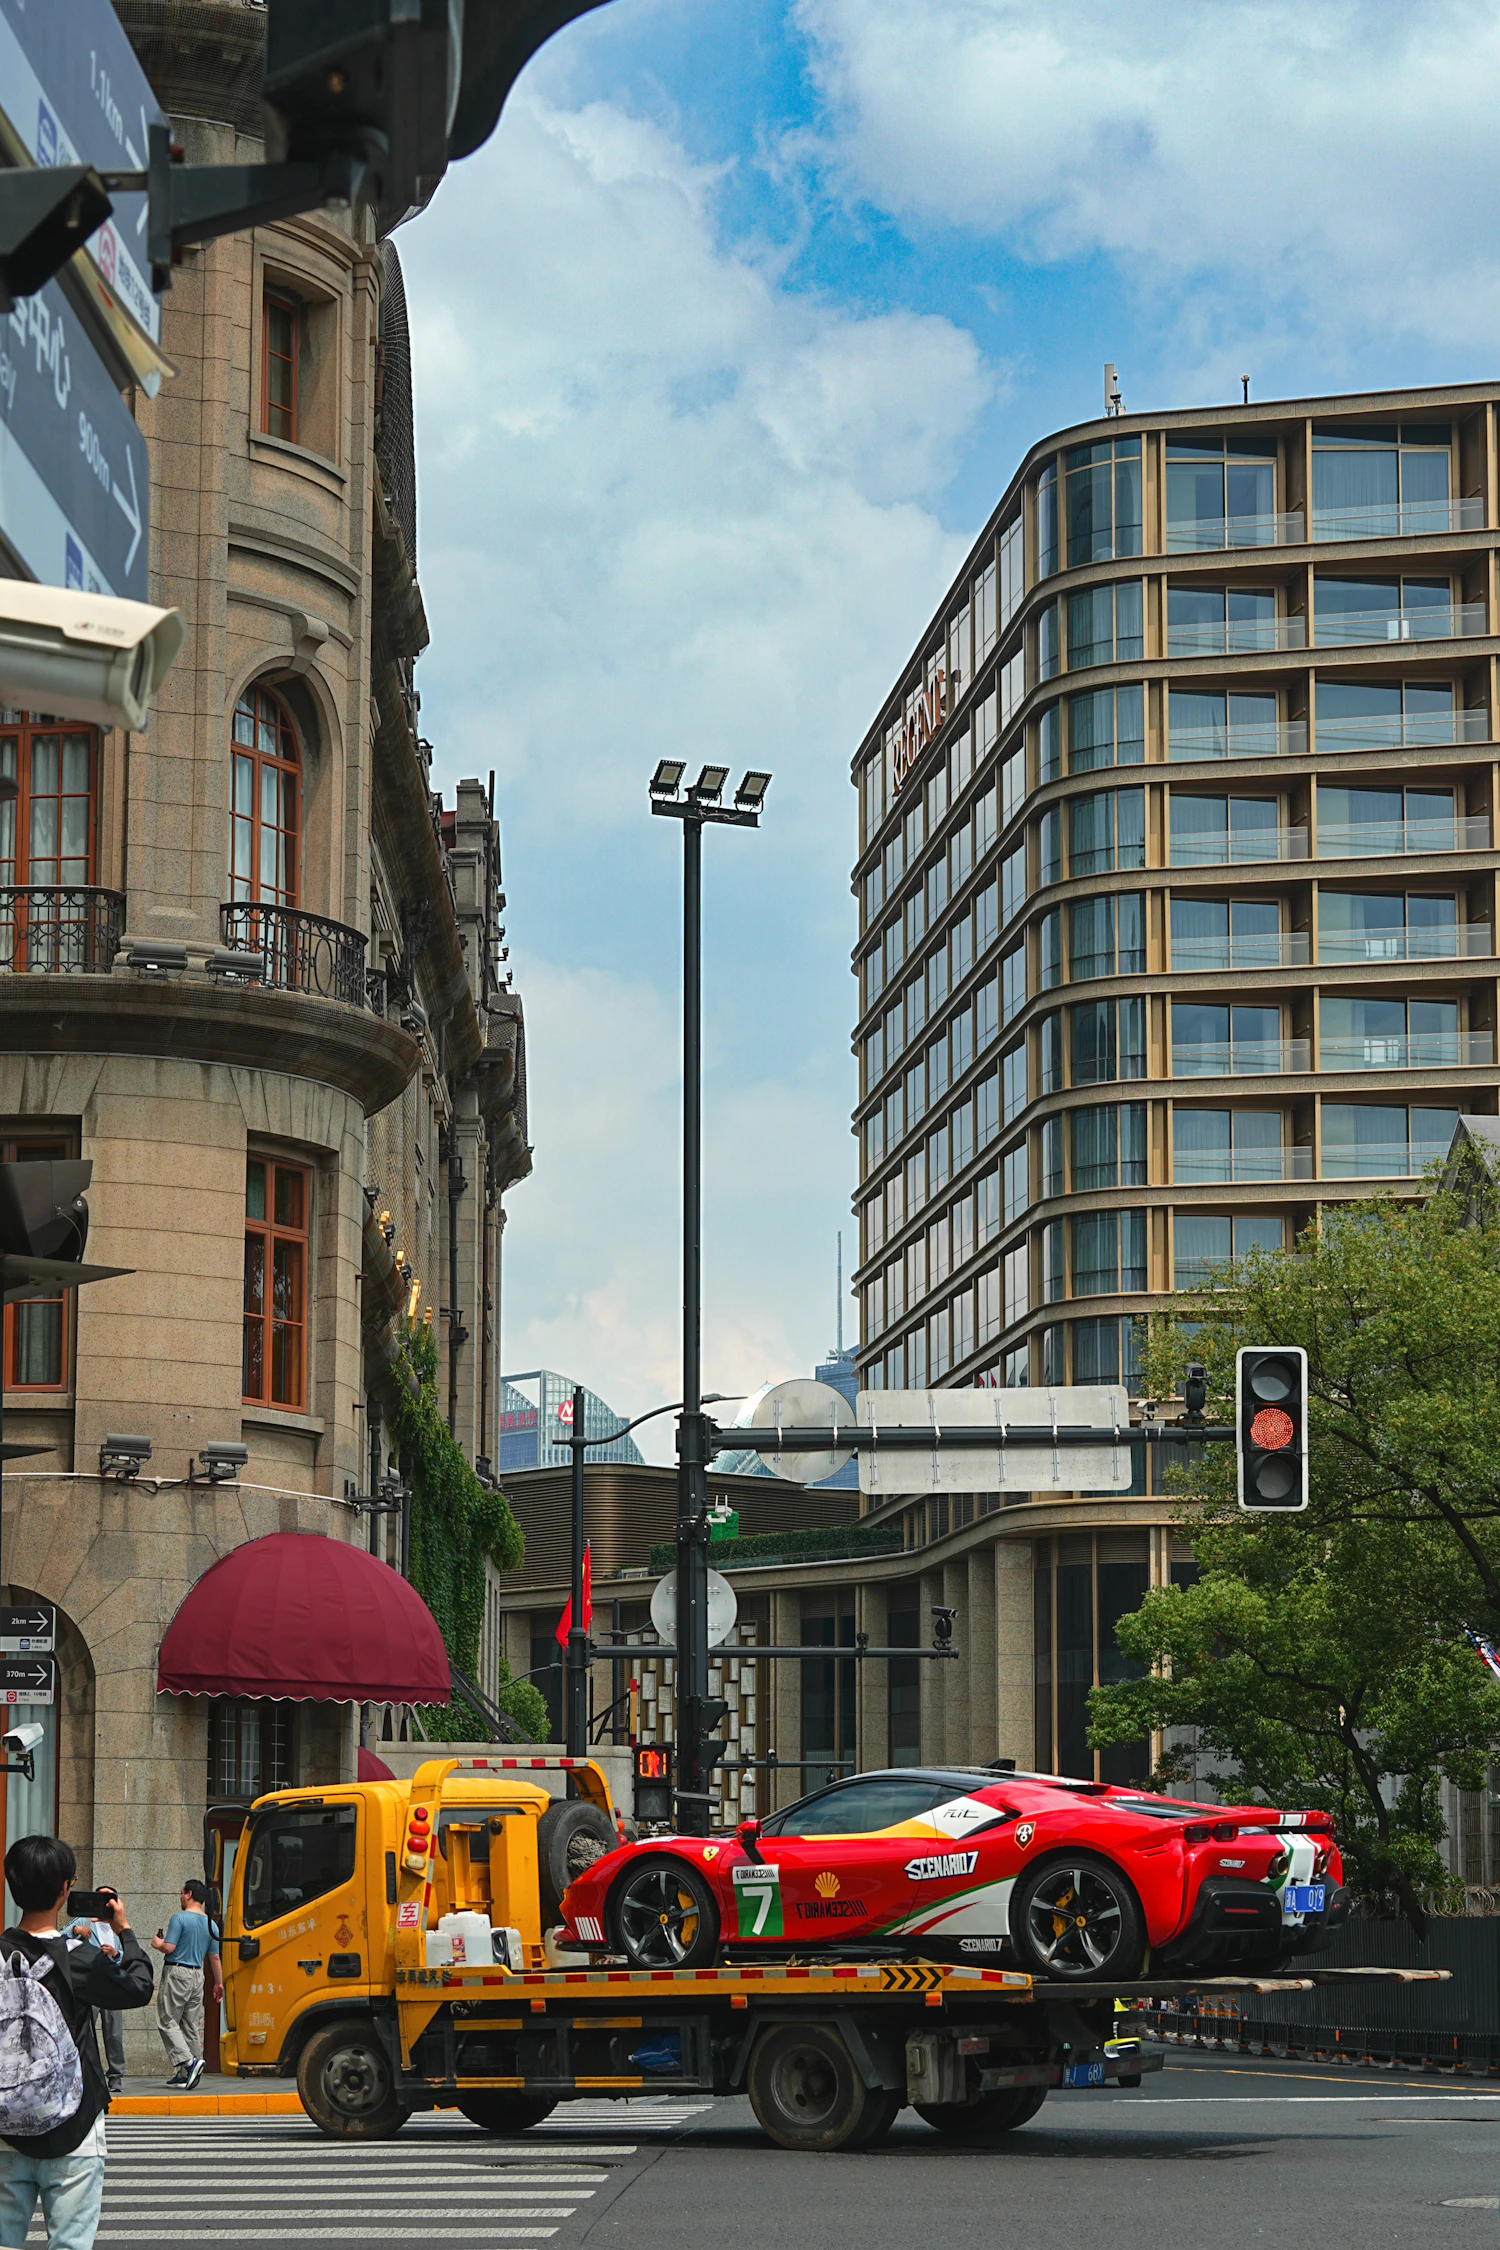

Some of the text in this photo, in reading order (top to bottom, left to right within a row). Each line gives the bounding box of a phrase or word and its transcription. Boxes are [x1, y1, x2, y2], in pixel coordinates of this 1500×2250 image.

[90, 50, 123, 145] 1.1km
[79, 411, 110, 493] 900m
[11, 1617, 27, 1625] 2km
[6, 1670, 26, 1678] 370m
[741, 1885, 773, 1936] 7
